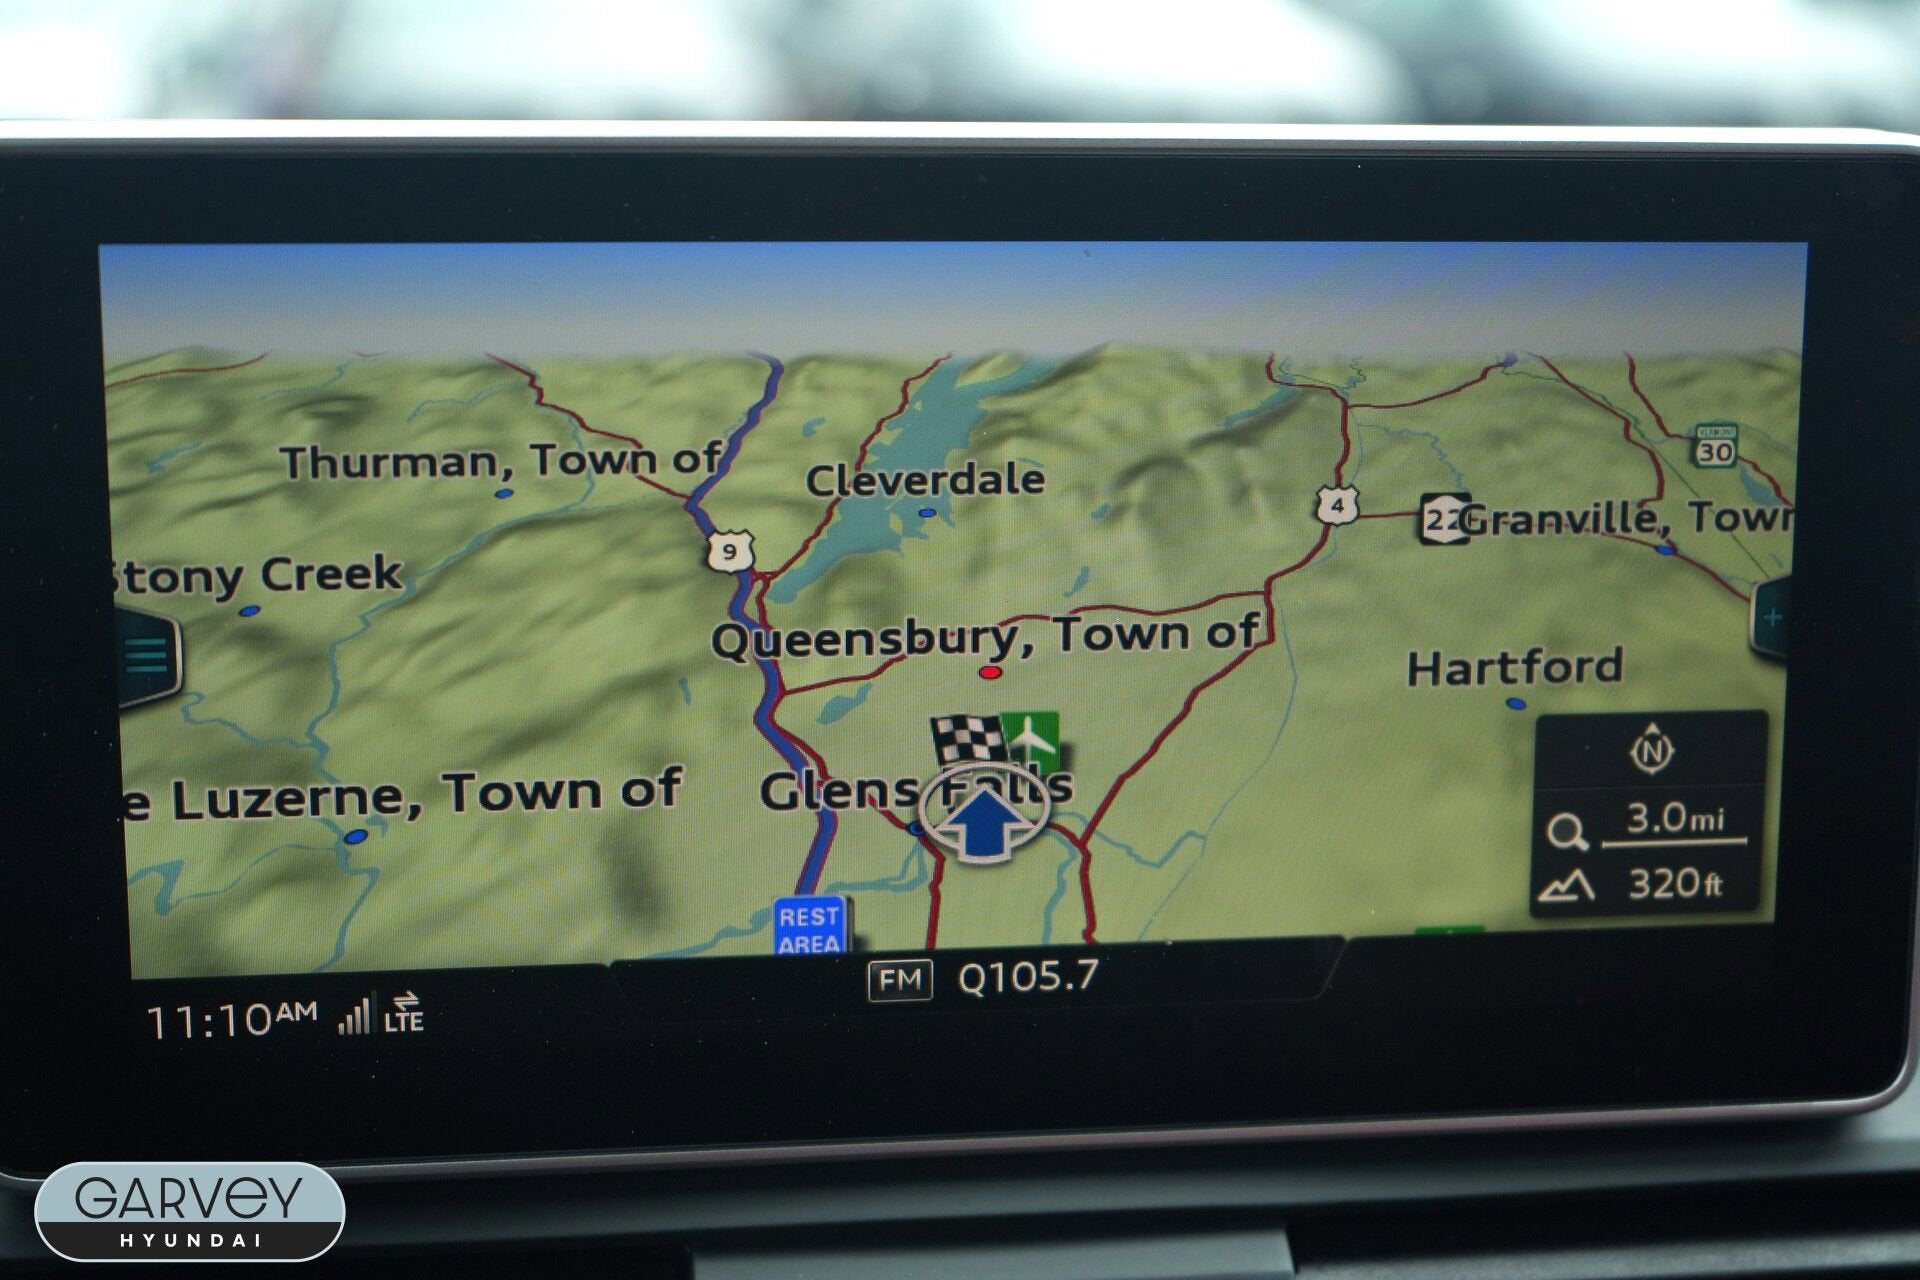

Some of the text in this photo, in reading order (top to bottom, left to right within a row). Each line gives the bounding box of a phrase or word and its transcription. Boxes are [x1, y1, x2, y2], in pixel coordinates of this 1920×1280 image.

[278, 439, 724, 482] Thurman, Town of
[1700, 443, 1733, 462] 30
[806, 462, 1046, 498] Cleverdale
[1331, 498, 1345, 513] 4
[1458, 500, 1671, 539] Granville,
[722, 544, 737, 561] 9
[260, 552, 404, 592] Creek
[712, 611, 1261, 663] Queensbury, Town of
[1407, 646, 1623, 687] Hartford
[1642, 741, 1663, 762] N
[173, 780, 422, 821] Luzerne,
[442, 772, 601, 812] Town
[620, 765, 684, 808] of
[760, 767, 919, 811] Glens
[780, 907, 840, 927] REST
[779, 935, 841, 954] AREA
[880, 959, 1100, 997] FM Q105.7
[384, 1012, 424, 1033] LTE
